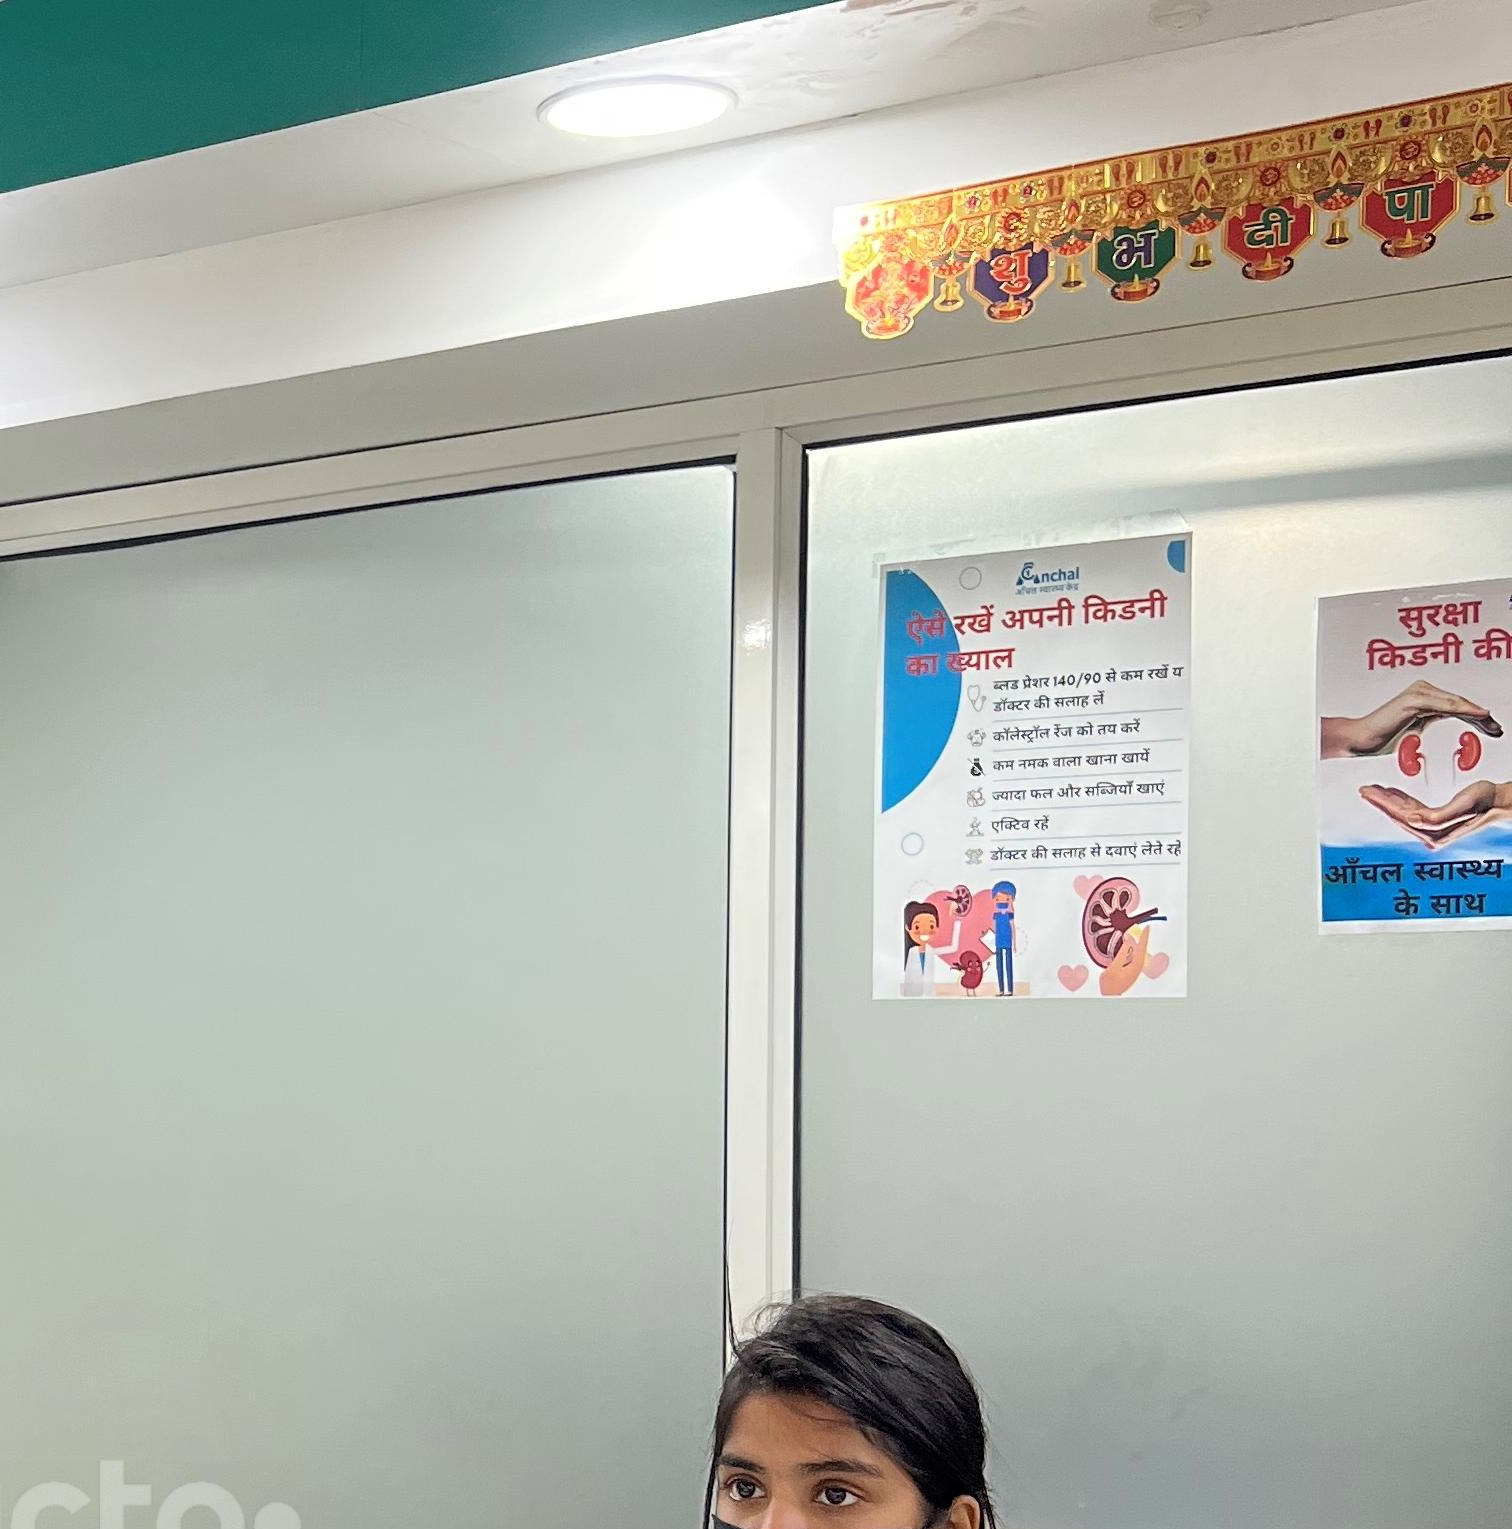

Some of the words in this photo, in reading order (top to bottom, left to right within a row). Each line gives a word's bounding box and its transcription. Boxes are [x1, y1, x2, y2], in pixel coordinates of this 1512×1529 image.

[953, 604, 994, 635] रखें
[1000, 598, 1075, 631] अपनी
[1083, 589, 1168, 625] किडनी
[1398, 599, 1482, 638] सुरक्षा
[905, 655, 938, 676] का
[945, 648, 1015, 673] ख्याल
[1366, 632, 1464, 671] किडनी
[993, 678, 1018, 691] ब्लड
[1022, 674, 1050, 690] प्रेशर
[1053, 671, 1101, 688] 140/90
[1105, 668, 1117, 683] से
[1120, 669, 1143, 681] कम
[1147, 664, 1168, 680] रखें
[993, 697, 1031, 713] डॉक्टर
[1033, 696, 1050, 710] की
[1054, 695, 1089, 708] सलाह
[1093, 689, 1105, 705] लें
[993, 724, 1050, 744] कॉलेस्ट्रॉल
[1054, 723, 1072, 738] रेंज
[1076, 720, 1093, 736] को
[1097, 722, 1117, 736] तय
[1120, 717, 1141, 734] करें
[992, 759, 1014, 771] कम
[1018, 757, 1049, 770] नमक
[1052, 755, 1081, 768] वाला
[1085, 752, 1117, 765] खाना
[1121, 748, 1151, 764] खायें
[991, 788, 1026, 802] ज्यादा
[1030, 787, 1053, 800] फल
[1057, 783, 1082, 799] और
[991, 816, 1030, 834] एक्टिव
[1034, 814, 1049, 832] रहें
[990, 847, 1028, 862] डॉक्टर
[1031, 846, 1048, 860] की
[1051, 846, 1086, 860] सलाह
[1090, 843, 1101, 857] से
[1141, 840, 1163, 855] लेते
[1325, 856, 1403, 884] आँचल
[1414, 858, 1504, 880] स्वास्थ्य
[1393, 888, 1420, 916] के
[1430, 892, 1486, 915] साथ
